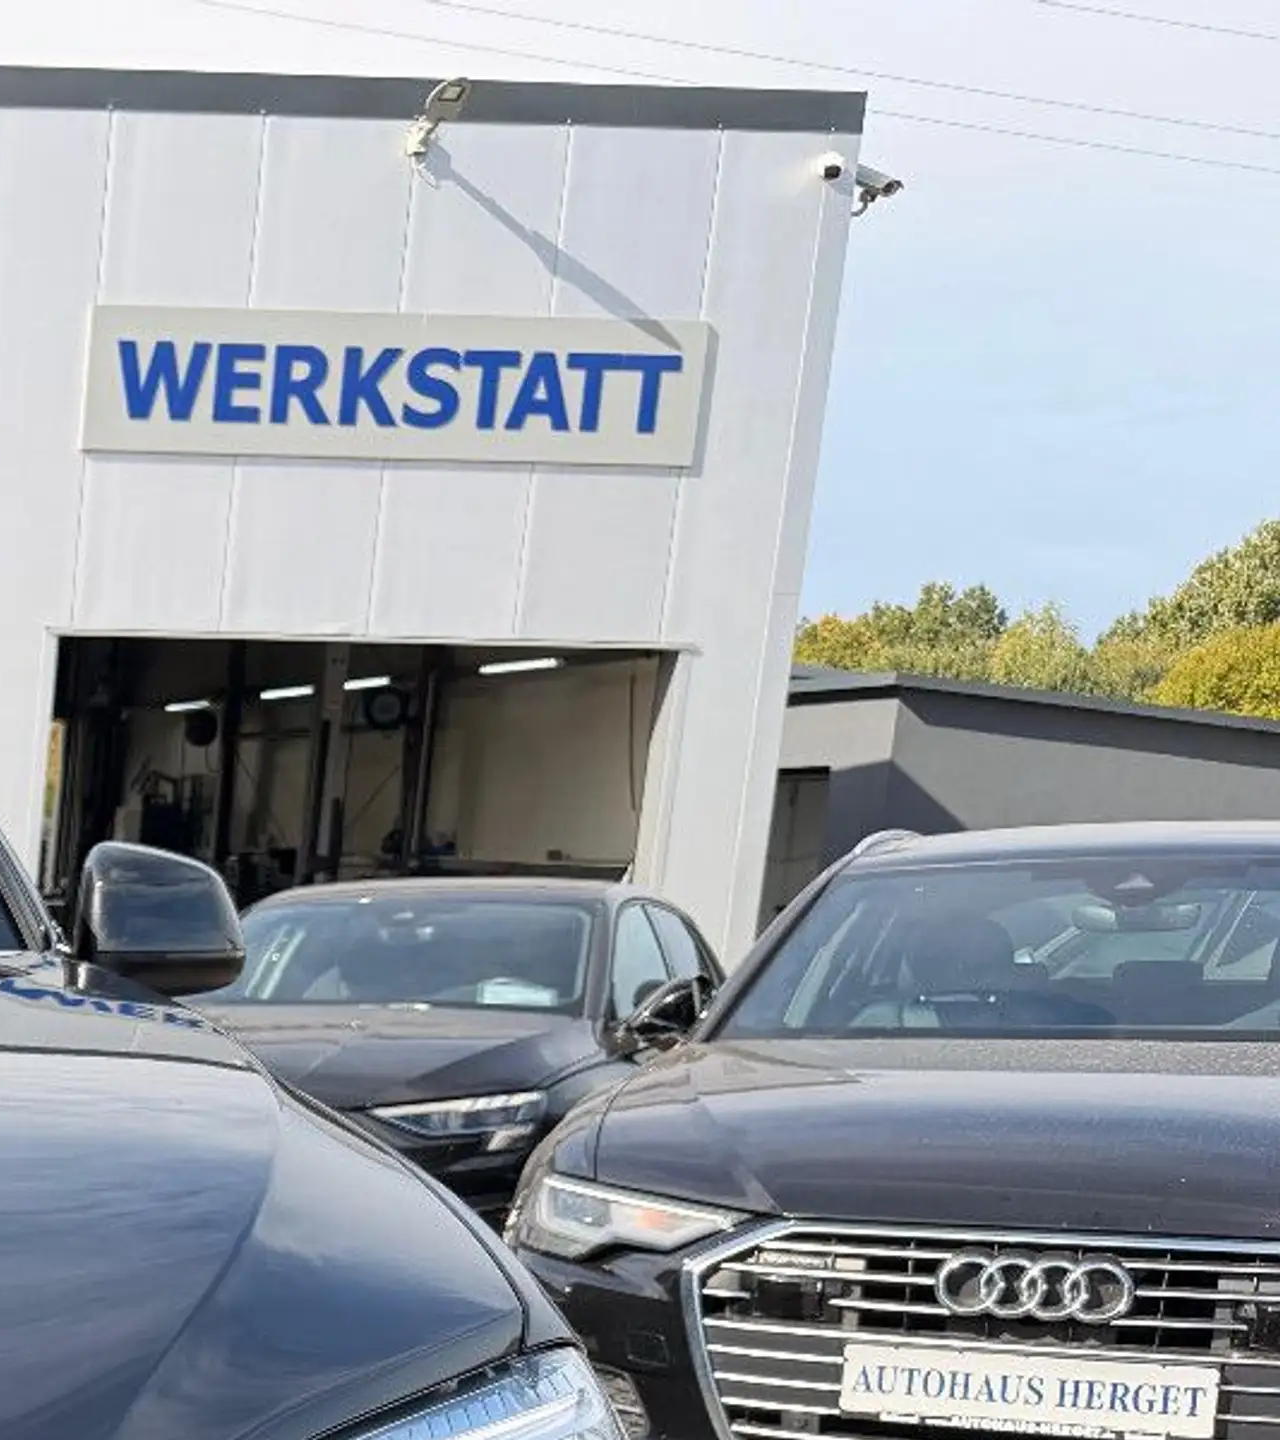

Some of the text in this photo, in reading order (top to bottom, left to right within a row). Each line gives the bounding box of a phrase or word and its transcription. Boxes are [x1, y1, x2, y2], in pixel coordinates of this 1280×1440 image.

[118, 339, 683, 434] WERKSTATT
[852, 1364, 1207, 1418] AUTOHAUS HERGET
